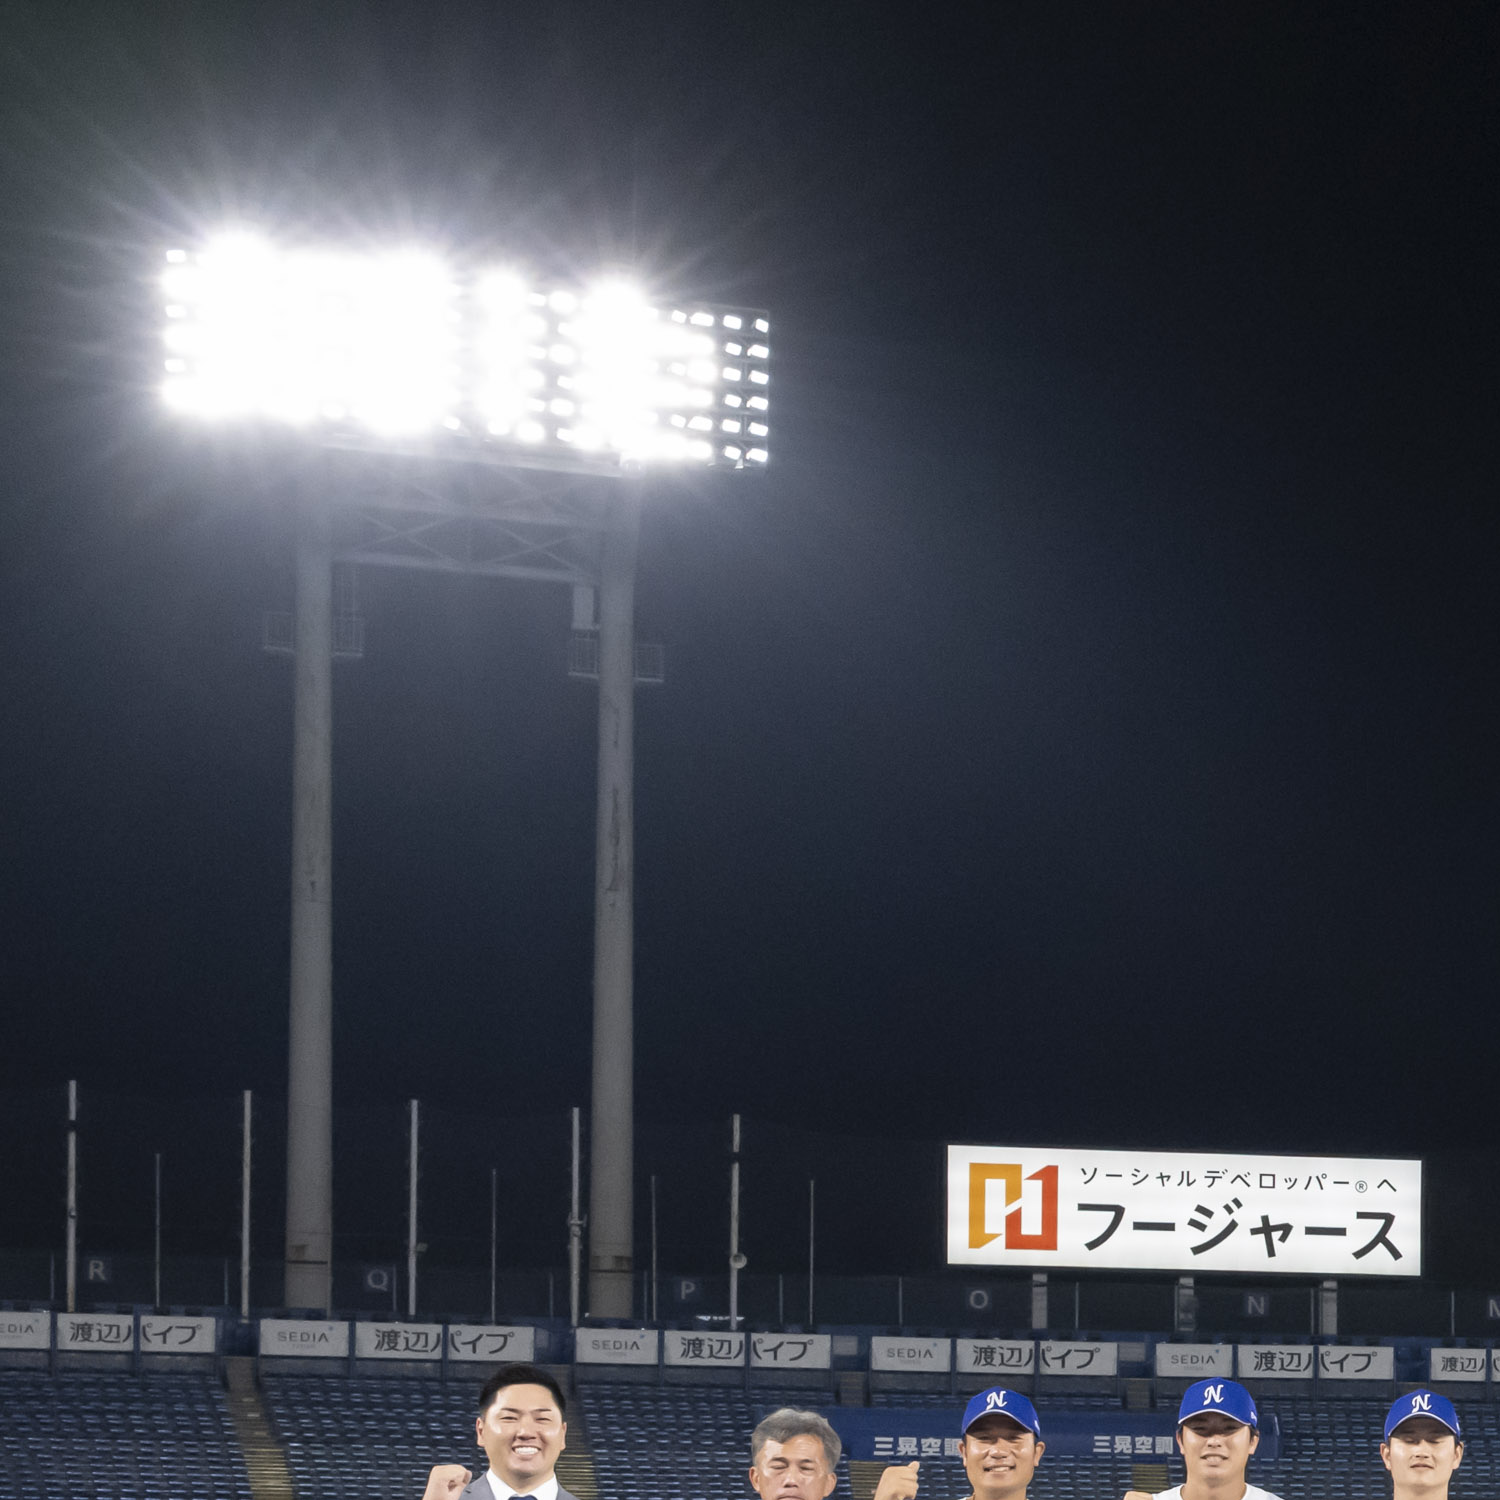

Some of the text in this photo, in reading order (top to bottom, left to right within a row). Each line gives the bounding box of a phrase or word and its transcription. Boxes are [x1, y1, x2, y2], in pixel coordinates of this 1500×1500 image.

[1077, 1197, 1403, 1262] フージャース
